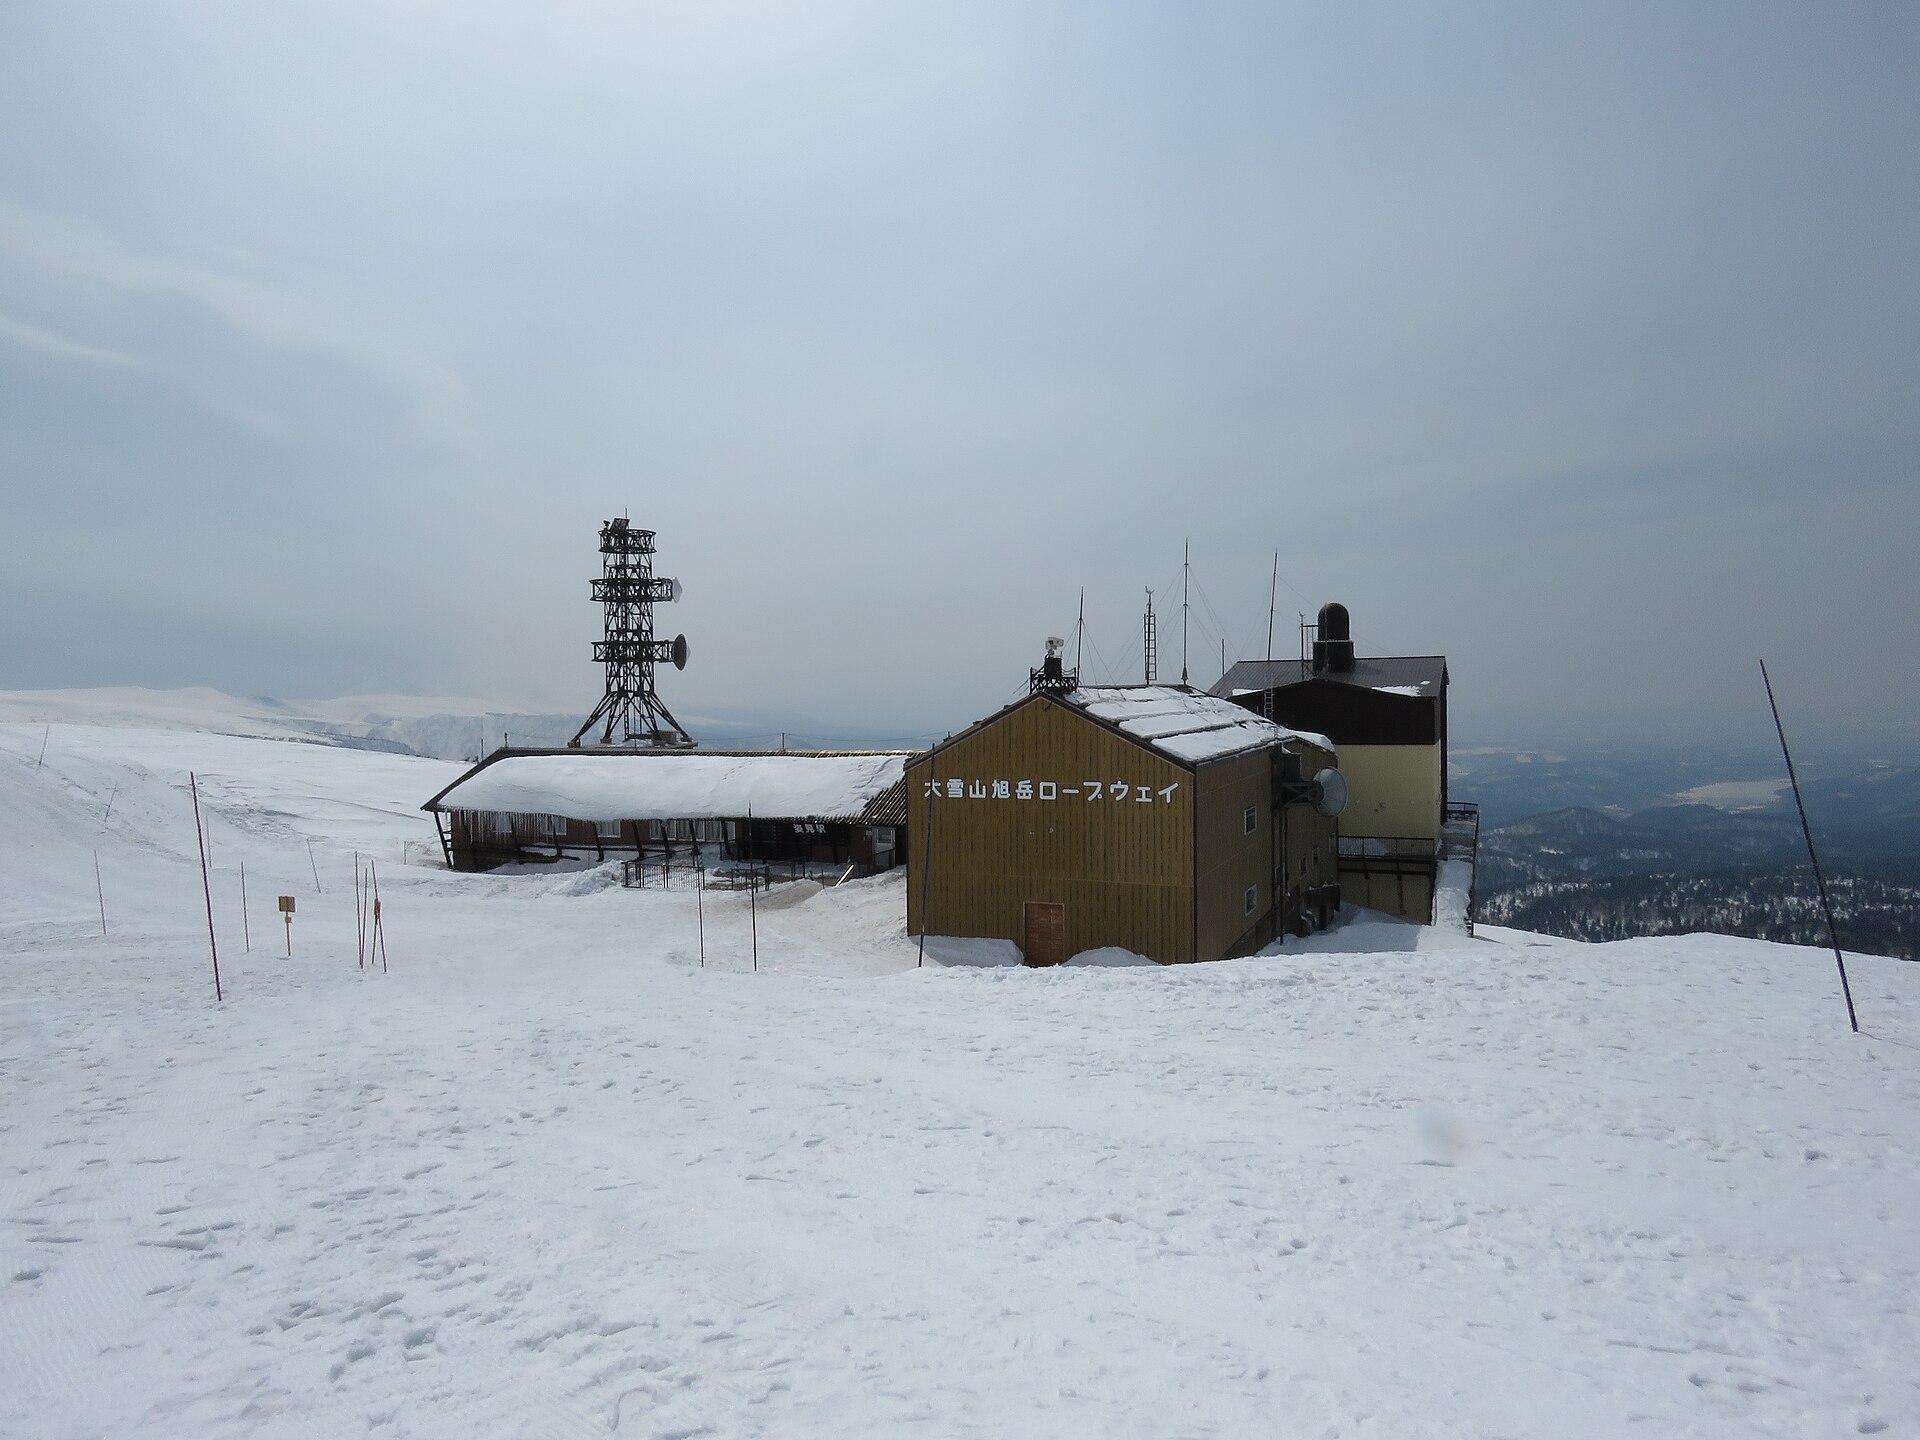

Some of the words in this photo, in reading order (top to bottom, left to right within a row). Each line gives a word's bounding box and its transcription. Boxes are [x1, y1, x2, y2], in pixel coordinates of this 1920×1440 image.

[923, 778, 1179, 803] 大雪山旭岳ロープウェイ
